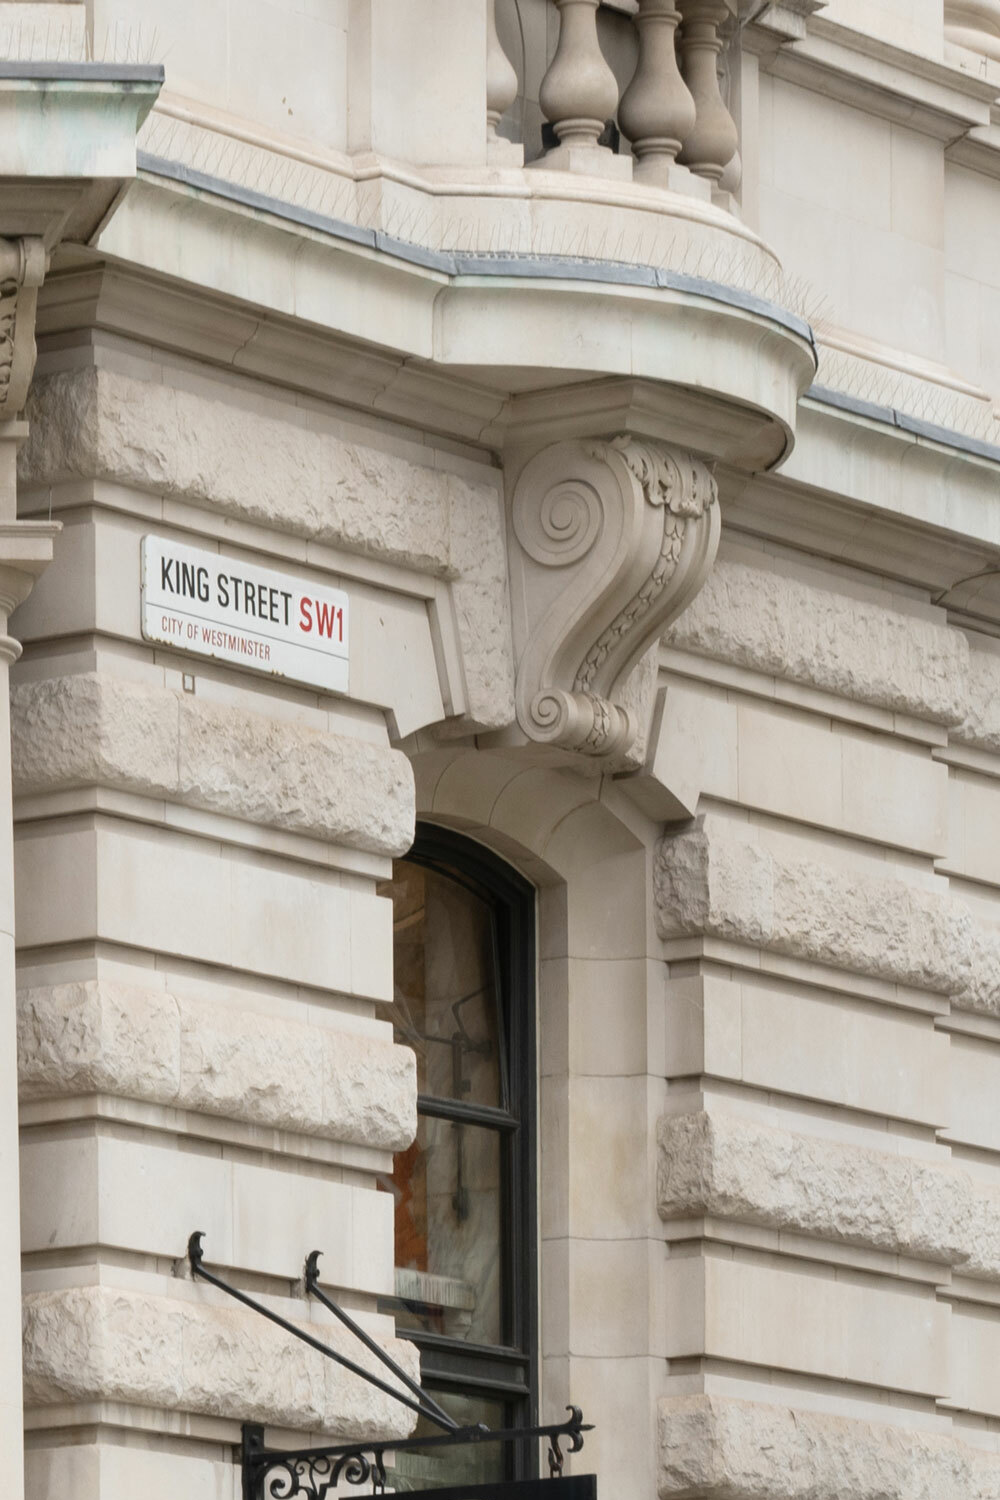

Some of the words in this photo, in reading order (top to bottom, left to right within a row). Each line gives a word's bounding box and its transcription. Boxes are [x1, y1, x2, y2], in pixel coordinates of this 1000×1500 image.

[160, 555, 210, 603] KING
[216, 573, 293, 626] STREET
[298, 596, 344, 643] SW1
[161, 615, 184, 639] CITY
[186, 623, 199, 640] OF
[202, 628, 271, 662] WESTMINSTER
